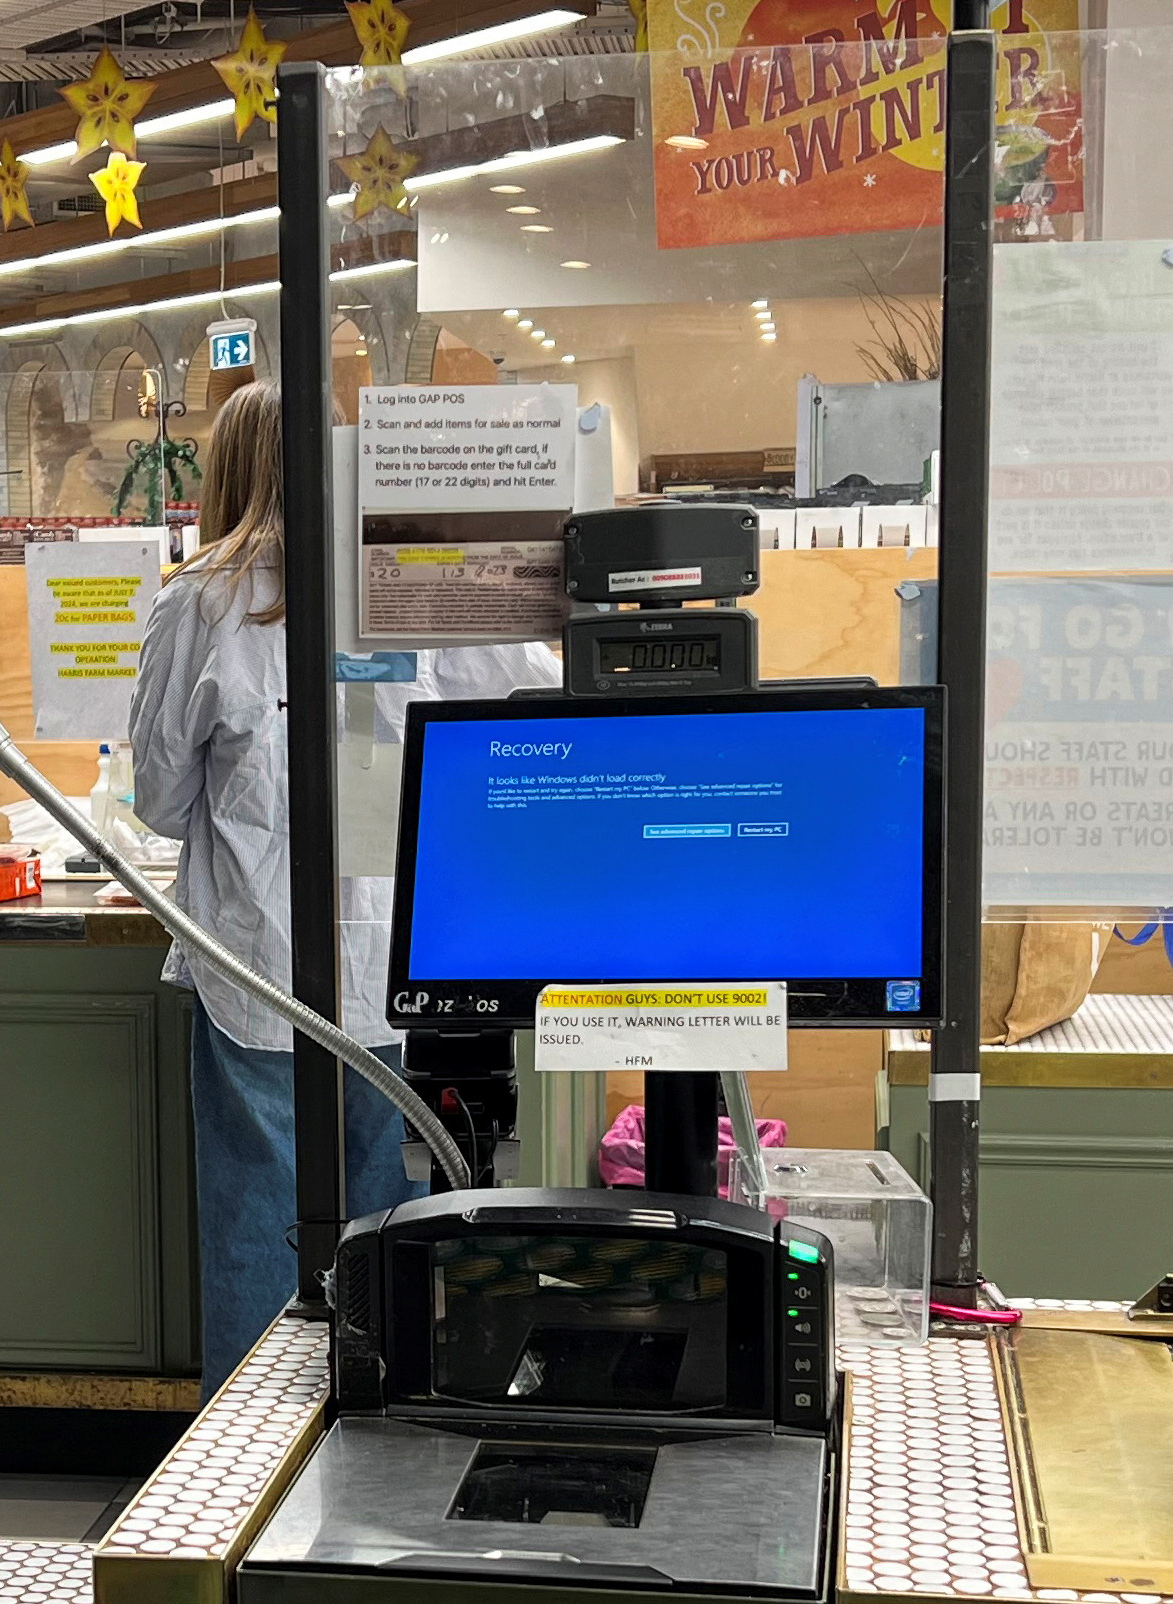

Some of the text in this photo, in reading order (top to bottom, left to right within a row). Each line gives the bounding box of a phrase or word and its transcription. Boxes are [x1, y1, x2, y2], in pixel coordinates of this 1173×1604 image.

[682, 0, 928, 139] WARM
[689, 47, 1043, 196] YOUR WINTR
[364, 393, 465, 405] 1. Log into GAP POS
[364, 420, 372, 429] 2.
[377, 419, 401, 429] Scan
[403, 419, 422, 429] and
[424, 419, 443, 429] add
[445, 419, 472, 429] items
[474, 419, 488, 429] for
[490, 419, 510, 428] sale
[526, 418, 561, 428] normal
[363, 444, 548, 456] 3. Scan the barcode on the gift card, if
[375, 459, 556, 471] there is no barcode enter the full card
[375, 477, 557, 489] number (17 or 22 digits) and hit Enter.
[82, 613, 110, 622] PAPER
[650, 623, 673, 631] ZEBRA
[50, 644, 75, 652] THANK
[76, 644, 91, 652] YOU
[92, 644, 108, 652] FOR
[109, 644, 128, 652] YOUR
[75, 655, 116, 664] OPERATION
[58, 668, 136, 677] HARRIS FARM MARKET
[489, 741, 573, 760] Recovery
[488, 773, 666, 785] It looks like Windows didn't load correctly
[540, 993, 623, 1005] ATTENTATION
[664, 993, 703, 1004] DON'T
[706, 993, 728, 1004] USE
[540, 1015, 781, 1028] IF YOU USE IT, WARNING LETTER WILL BE
[539, 1034, 584, 1045] ISSUED.
[625, 1056, 653, 1066] HFM
